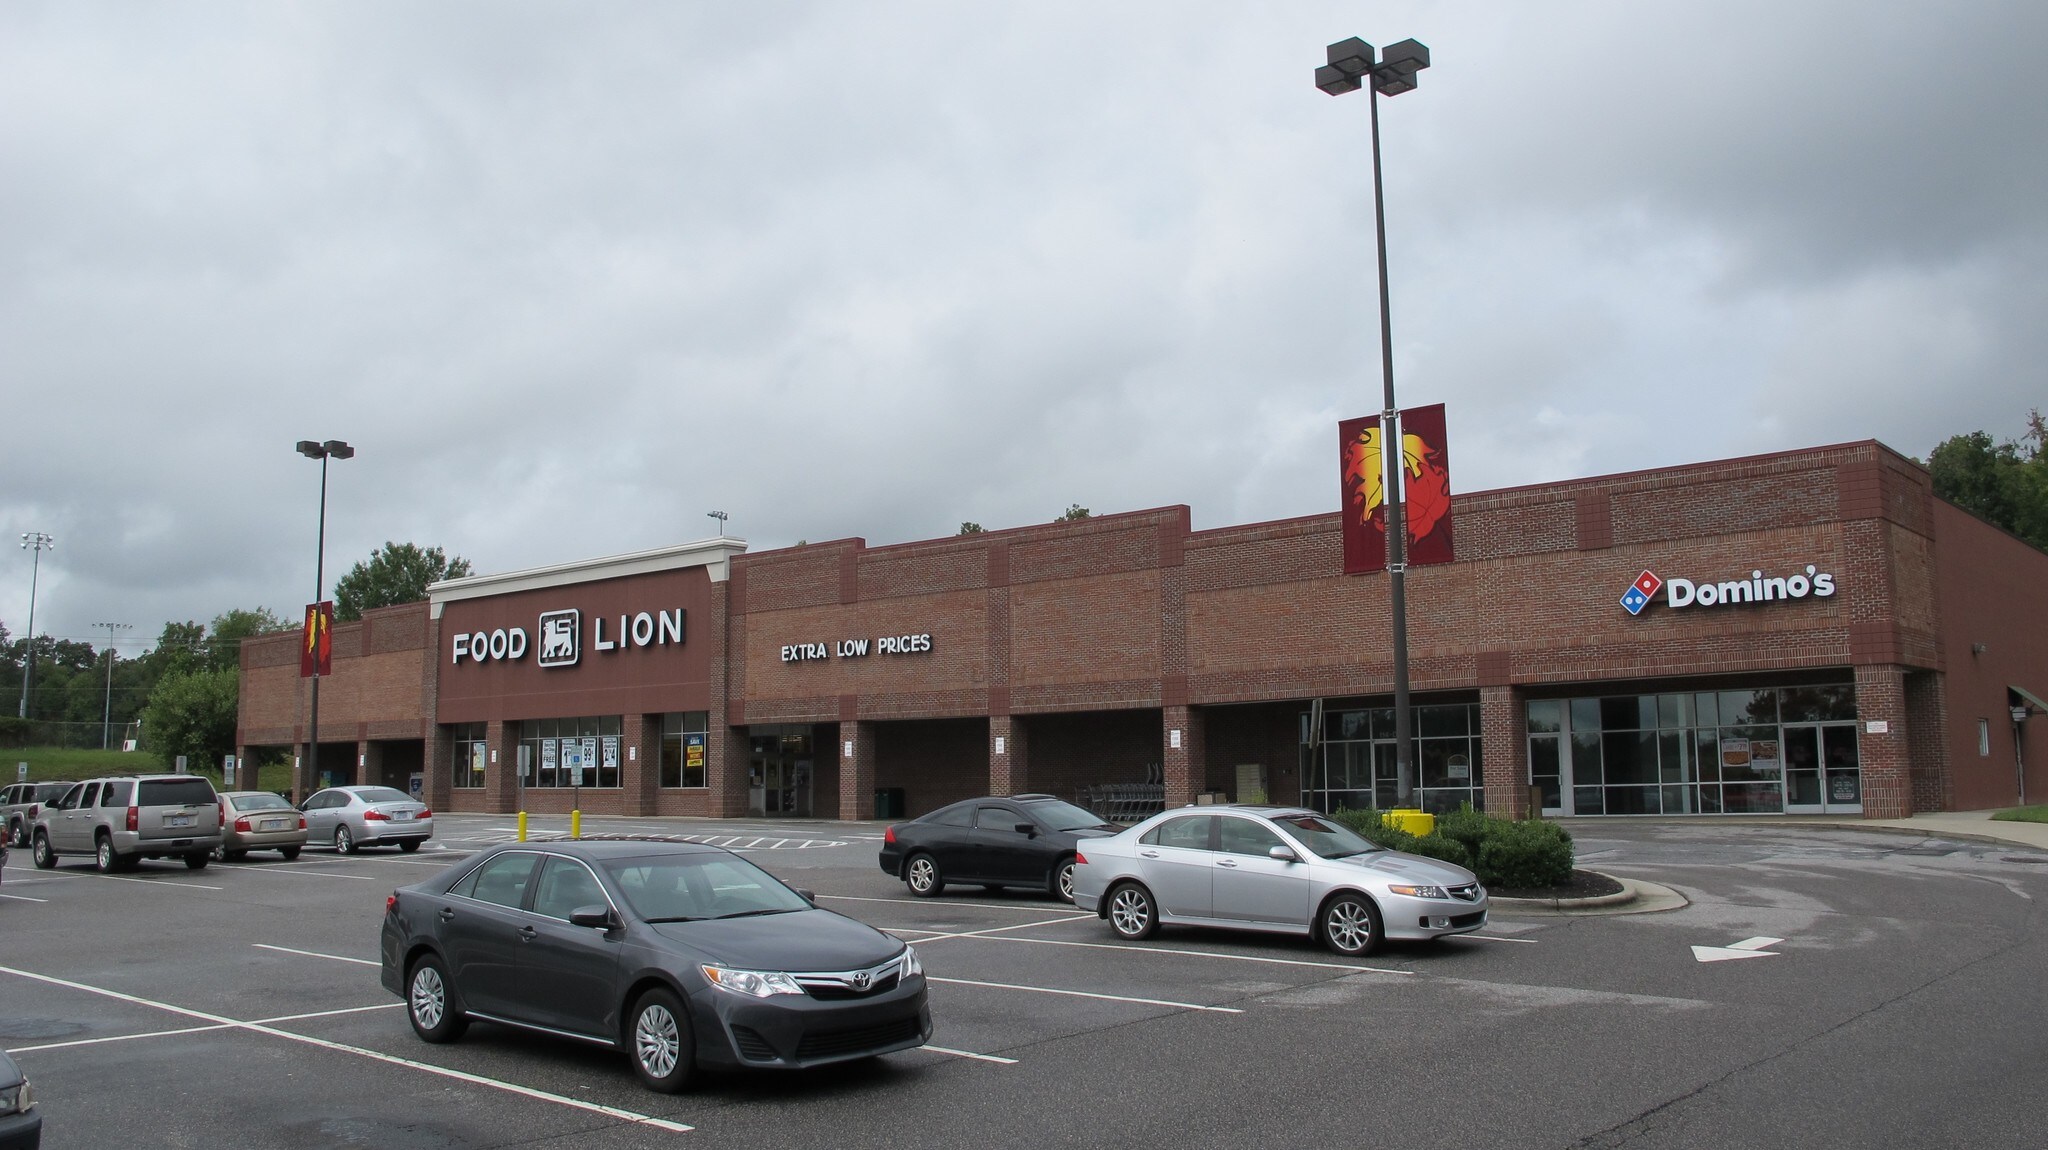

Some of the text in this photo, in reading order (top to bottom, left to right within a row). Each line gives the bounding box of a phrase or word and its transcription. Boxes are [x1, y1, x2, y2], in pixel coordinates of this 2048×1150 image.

[1667, 565, 1835, 608] Domino's
[453, 608, 683, 664] FOOD LION
[781, 633, 931, 662] EXTRA LOW PRICES
